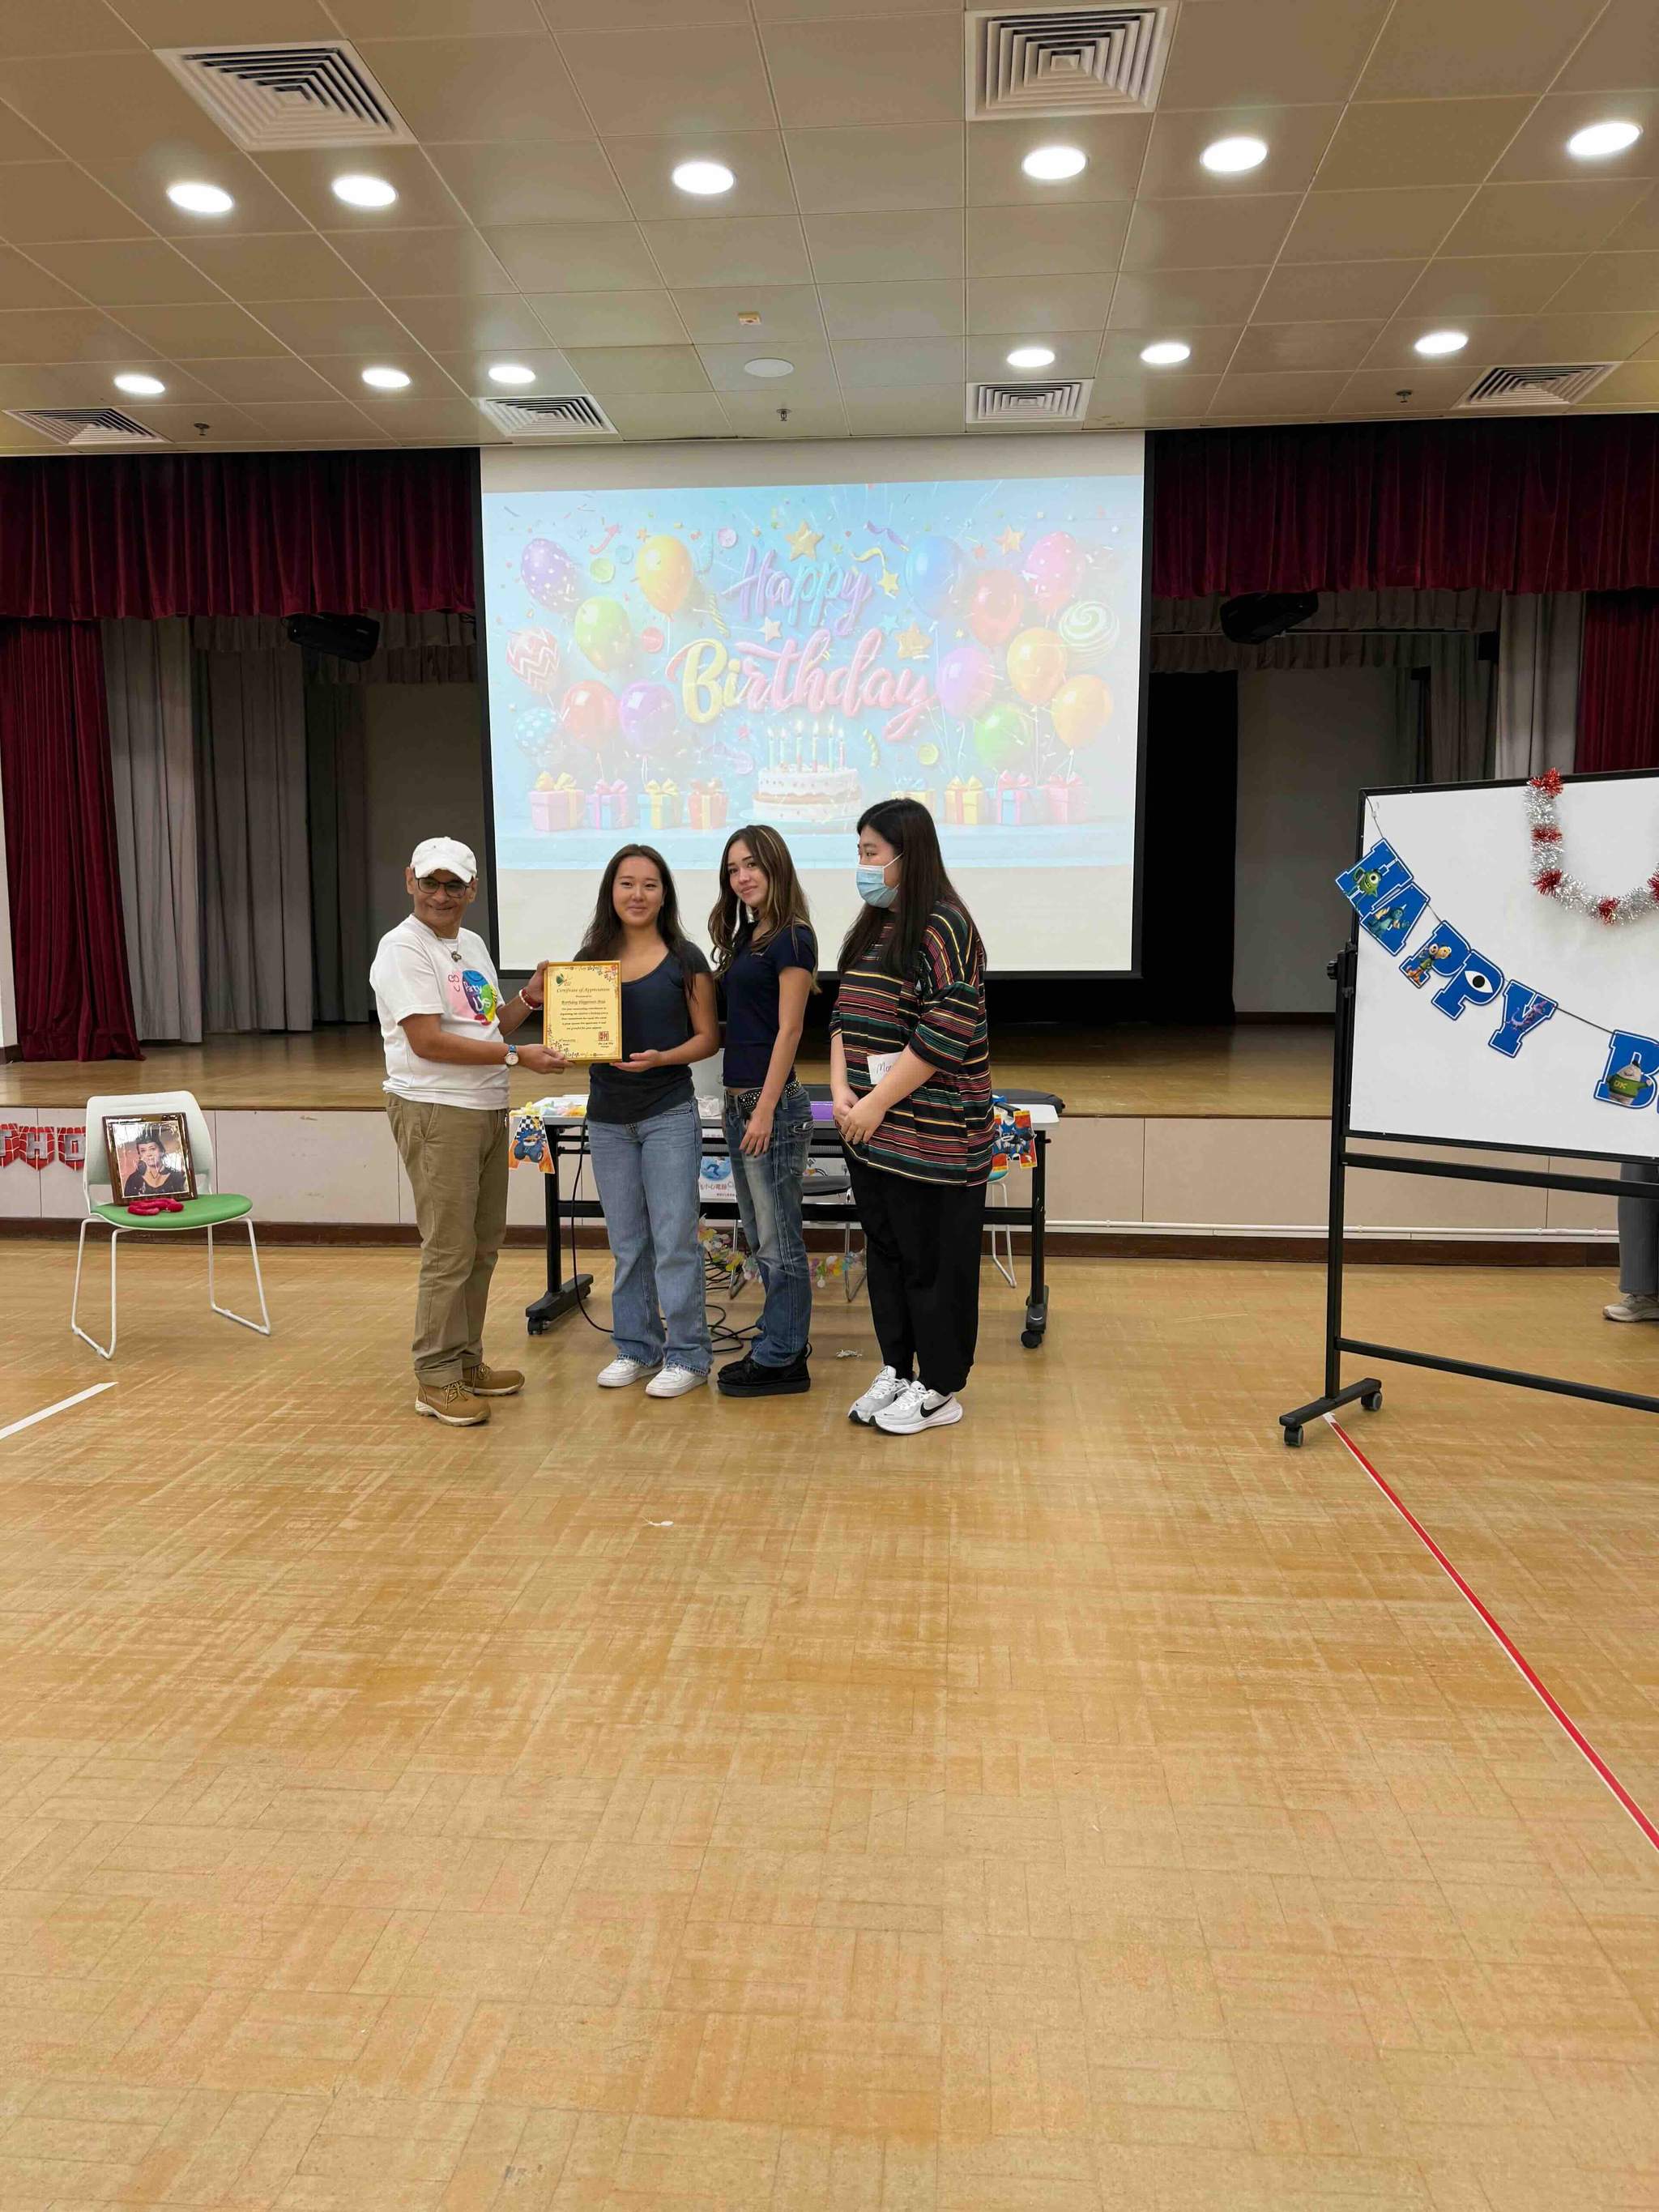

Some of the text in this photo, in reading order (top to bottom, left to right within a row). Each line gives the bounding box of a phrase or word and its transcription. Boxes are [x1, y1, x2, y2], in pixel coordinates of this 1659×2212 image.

[721, 545, 873, 636] Happy
[665, 629, 940, 742] Birthday
[1336, 837, 1659, 1115] HAPPY B
